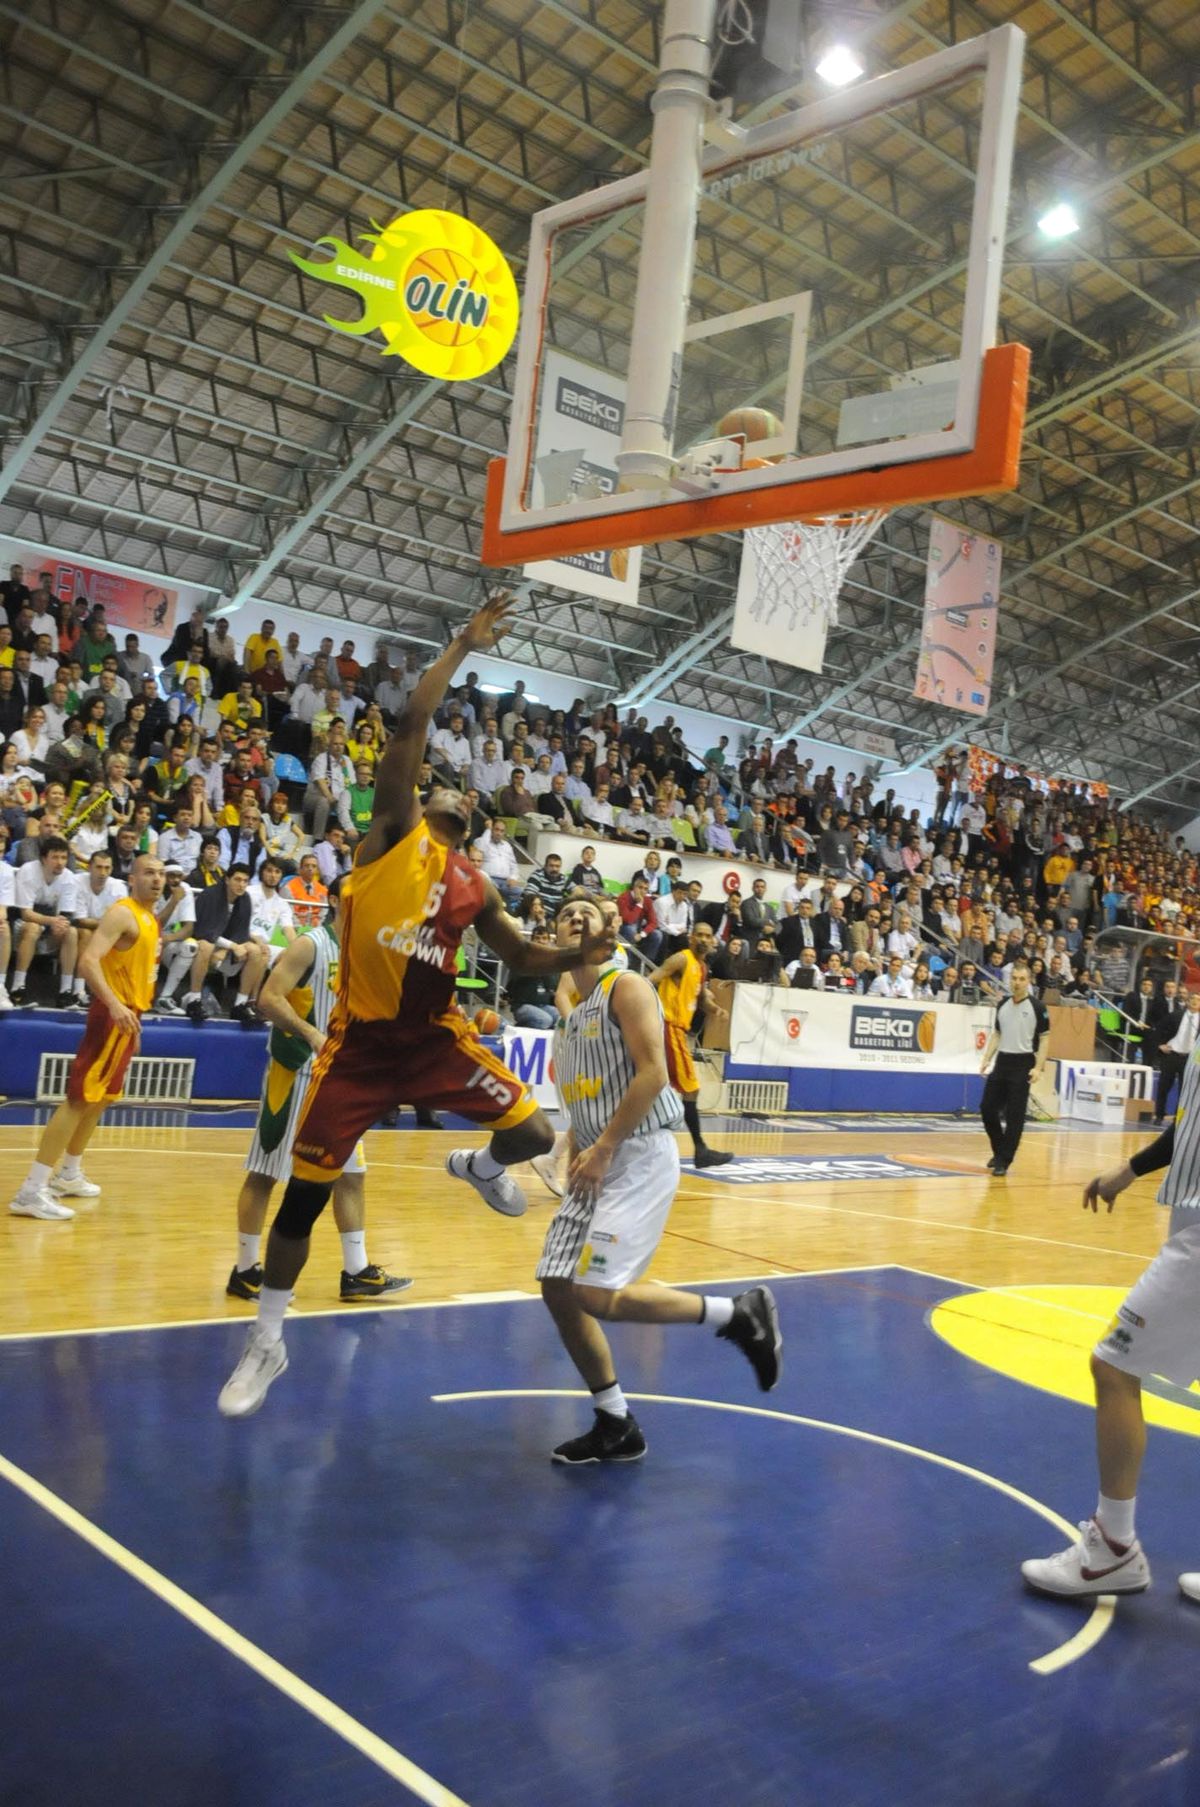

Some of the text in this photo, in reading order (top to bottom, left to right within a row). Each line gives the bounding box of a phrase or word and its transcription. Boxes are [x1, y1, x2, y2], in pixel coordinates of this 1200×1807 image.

[561, 387, 620, 423] BEKO
[376, 926, 448, 969] CROWN
[855, 1015, 915, 1038] BEKO
[465, 1066, 513, 1106] 15
